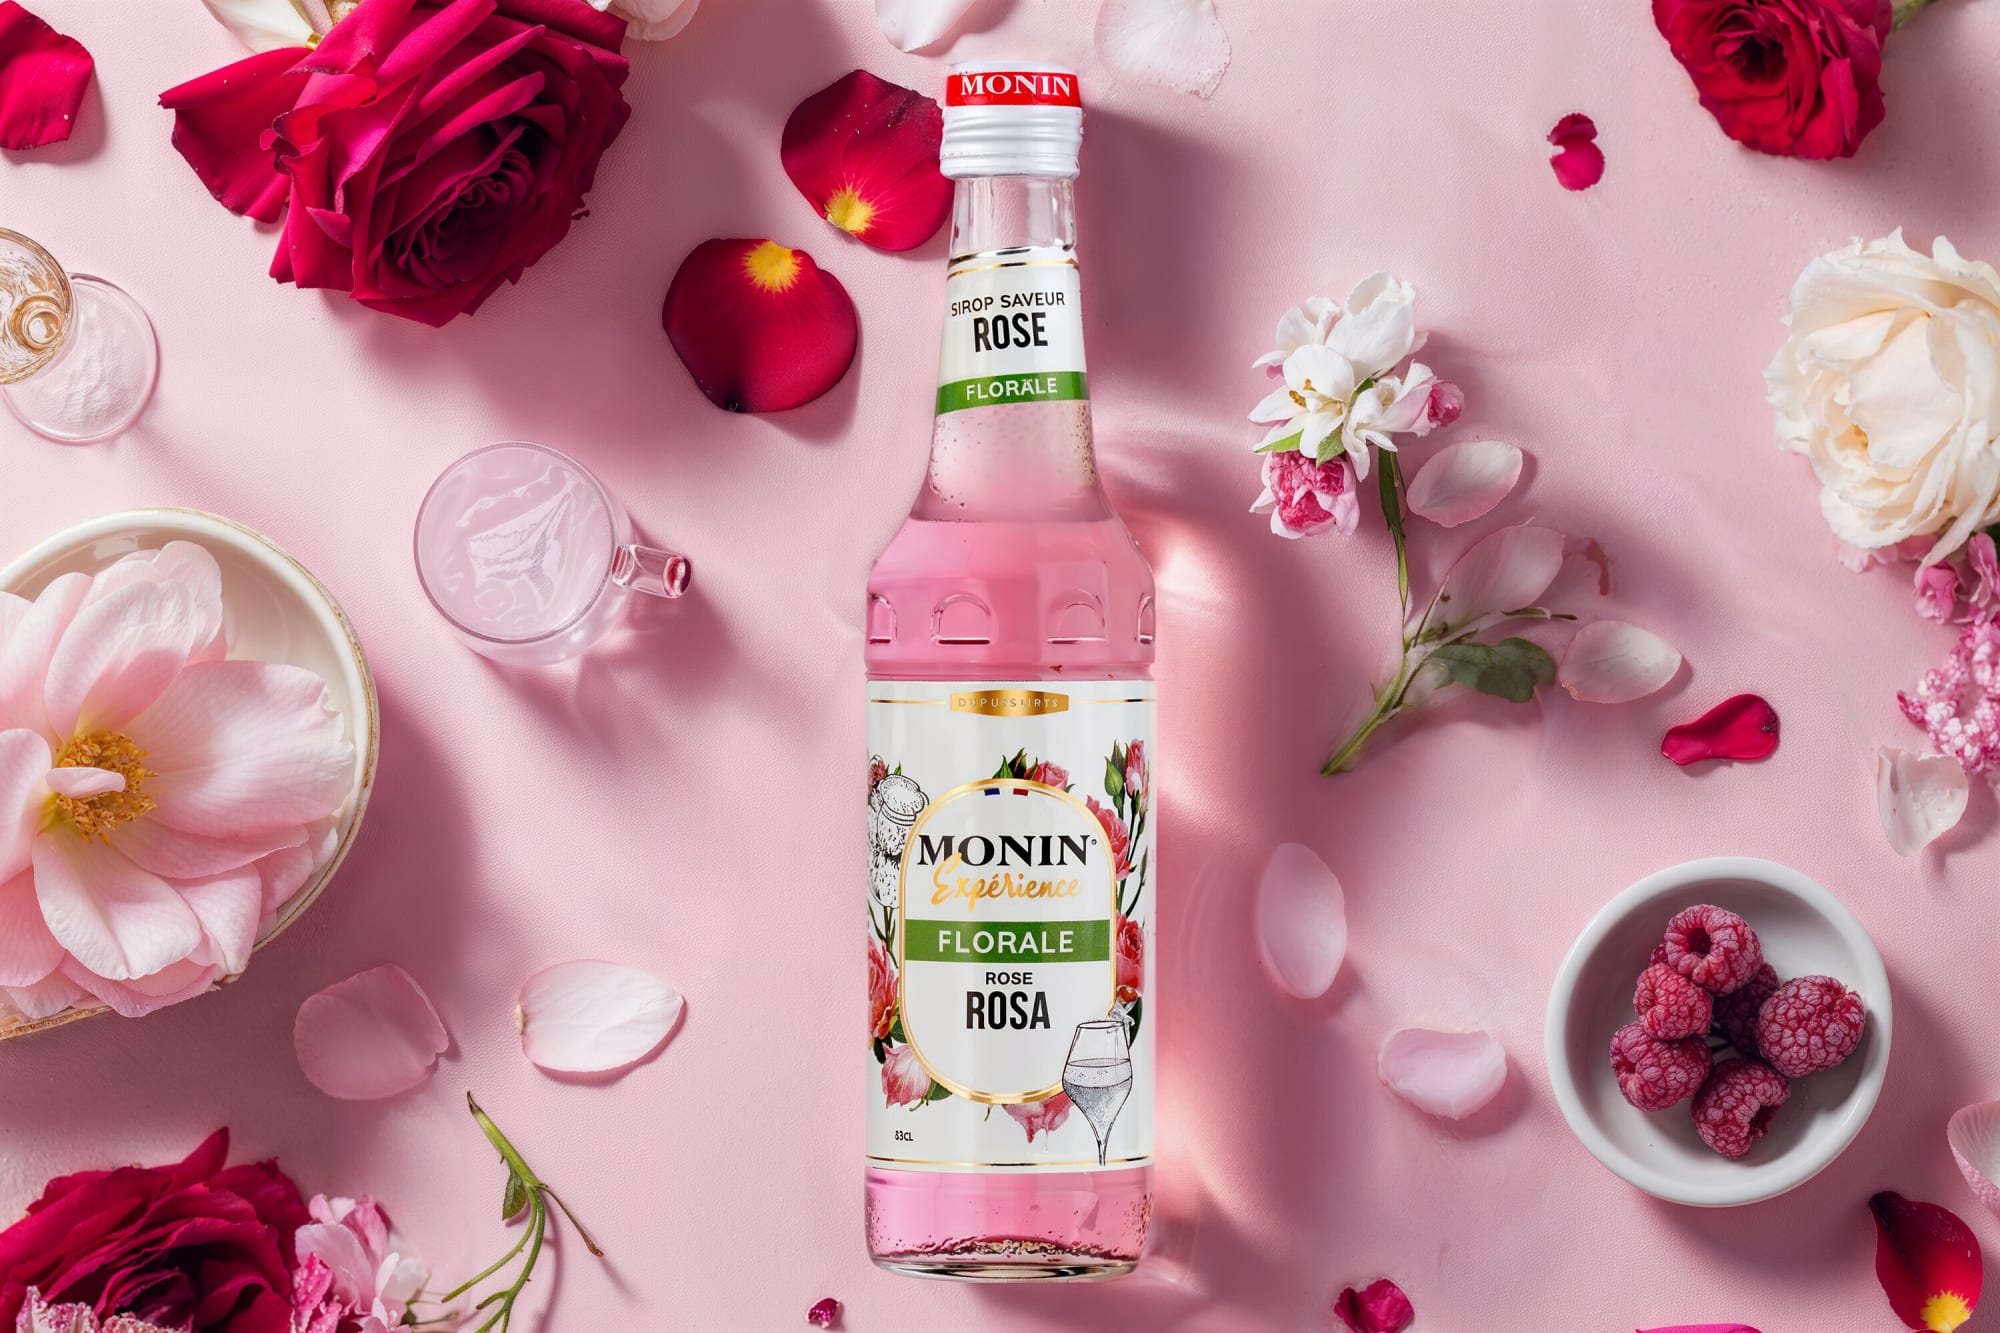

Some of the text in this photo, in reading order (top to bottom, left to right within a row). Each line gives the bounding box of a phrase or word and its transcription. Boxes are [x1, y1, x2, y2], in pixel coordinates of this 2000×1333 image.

[961, 75, 1070, 97] MONIN
[951, 292, 1065, 317] SIROP SAVEUR
[973, 312, 1048, 352] ROSE
[931, 852, 1083, 912] Expérience
[938, 930, 1074, 954] FLORALE
[985, 971, 1033, 985] ROSE
[966, 991, 1051, 1030] ROSA
